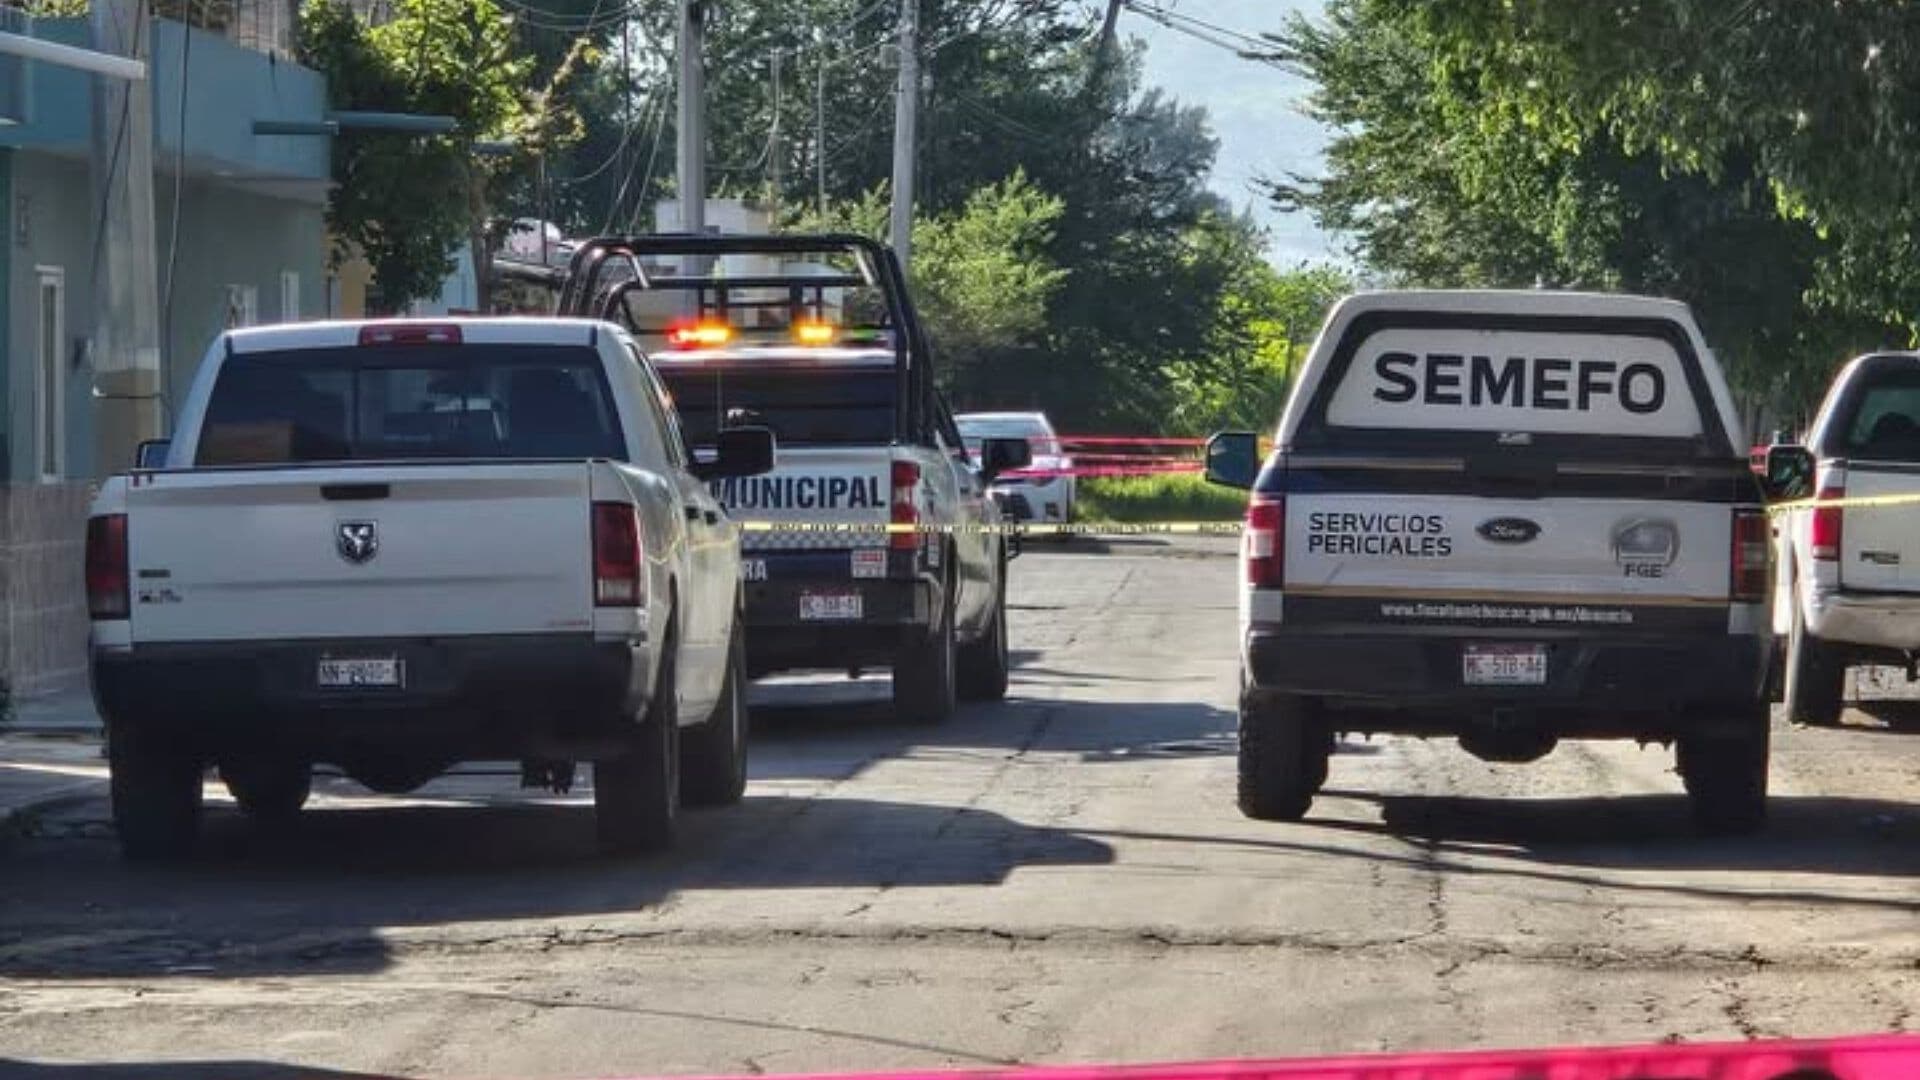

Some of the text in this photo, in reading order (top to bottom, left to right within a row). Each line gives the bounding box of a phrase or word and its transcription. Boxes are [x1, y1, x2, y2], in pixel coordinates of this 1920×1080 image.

[1372, 351, 1666, 415] SEMEFO
[710, 475, 886, 508] MUNICIPAL
[1308, 512, 1443, 534] SERVICIOS
[1308, 535, 1452, 557] PERICIALES
[1623, 563, 1663, 579] FGE
